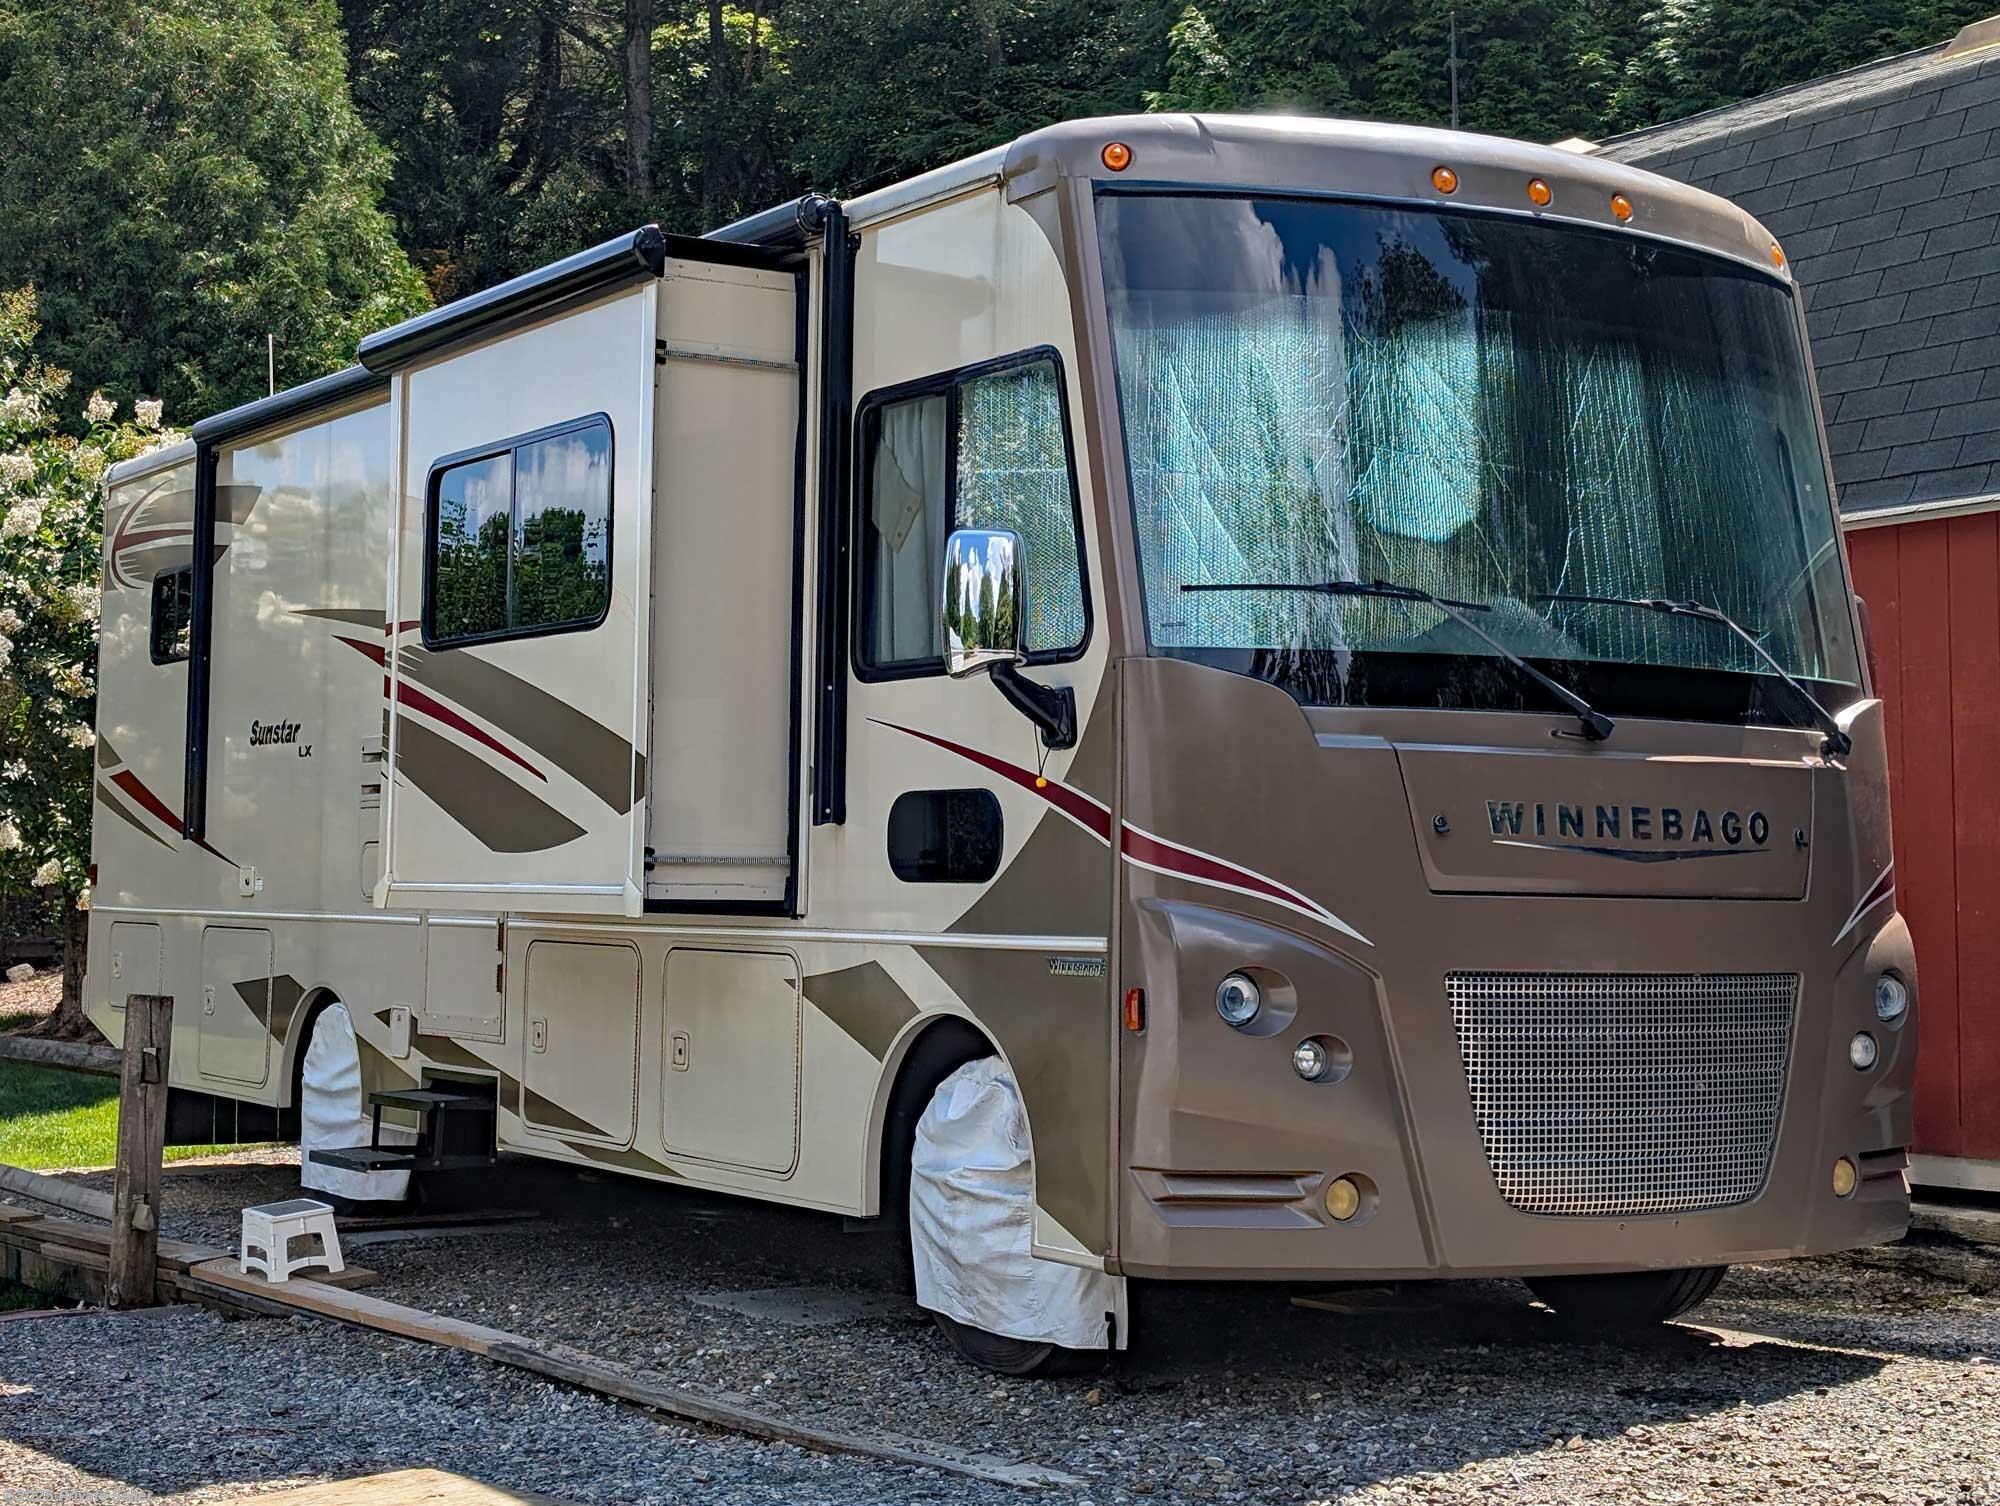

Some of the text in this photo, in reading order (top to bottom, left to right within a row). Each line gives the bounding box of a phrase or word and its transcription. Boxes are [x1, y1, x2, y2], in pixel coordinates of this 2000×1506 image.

[249, 718, 301, 746] Sunstar
[298, 745, 312, 758] LX
[1487, 800, 1769, 845] WINNEBAGO
